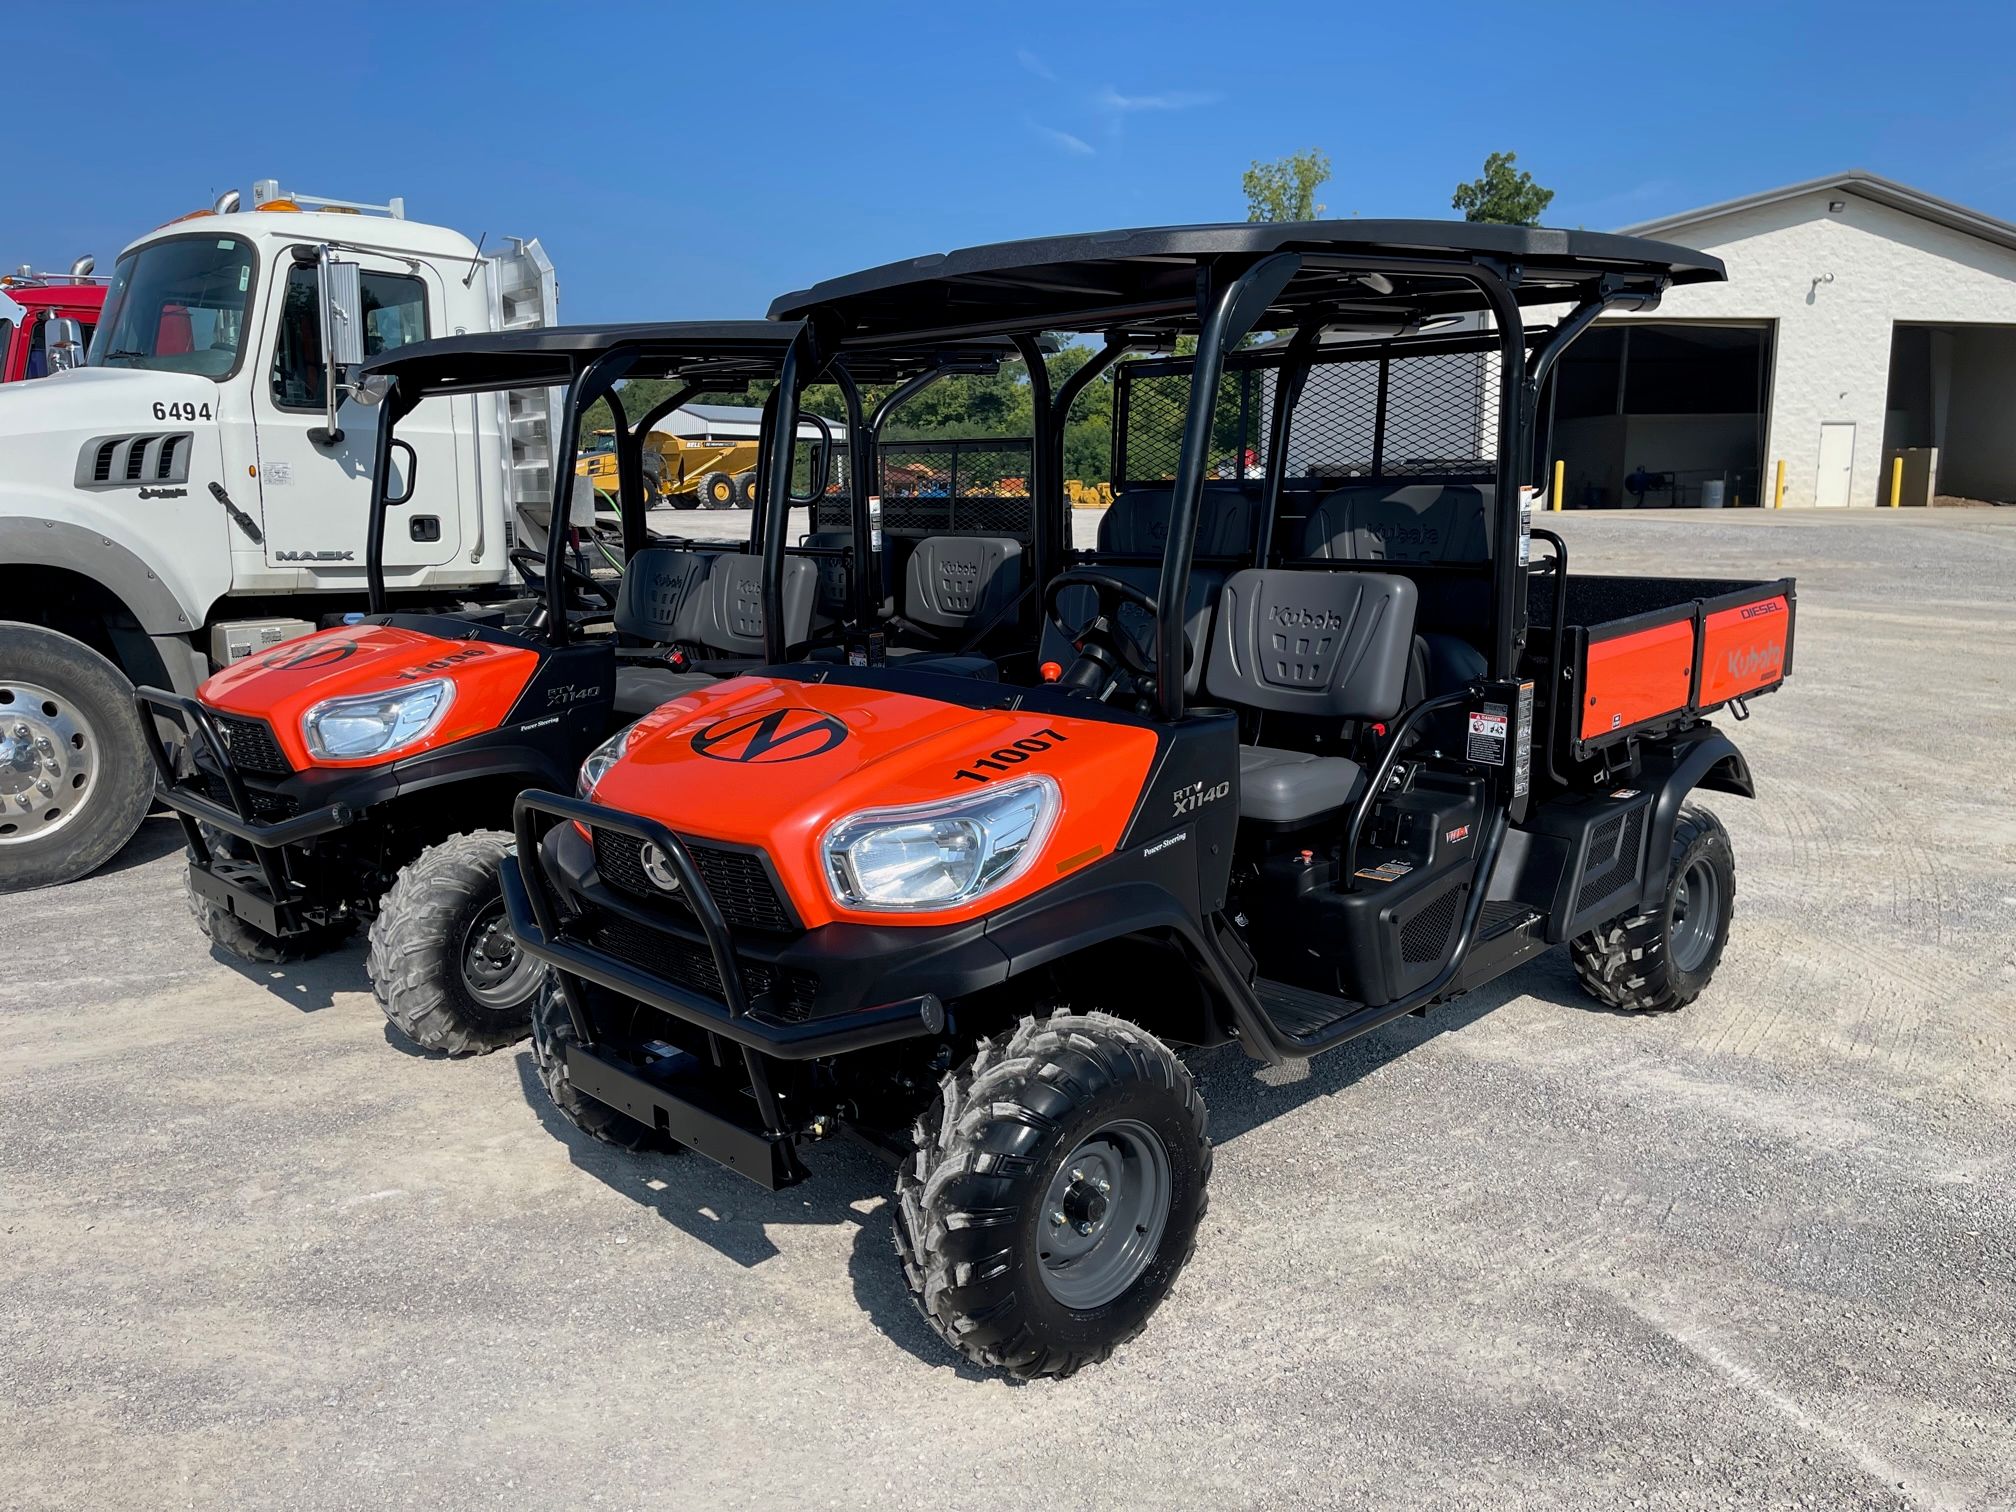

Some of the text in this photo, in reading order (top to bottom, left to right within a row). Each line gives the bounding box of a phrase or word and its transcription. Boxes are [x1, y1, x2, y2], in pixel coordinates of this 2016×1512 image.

[152, 401, 212, 421] 6494
[275, 550, 355, 561] MACK
[940, 560, 977, 577] Kubota
[1268, 605, 1342, 630] Kubota
[1740, 602, 1783, 619] DIESEL
[1727, 640, 1781, 680] Kubota
[546, 686, 601, 707] X1140
[547, 684, 575, 697] RTV
[520, 717, 560, 732] Power Steering
[953, 728, 1070, 783] 11007
[1172, 781, 1230, 818] X1140
[1173, 781, 1203, 802] RTV
[1143, 832, 1187, 858] Power Steering
